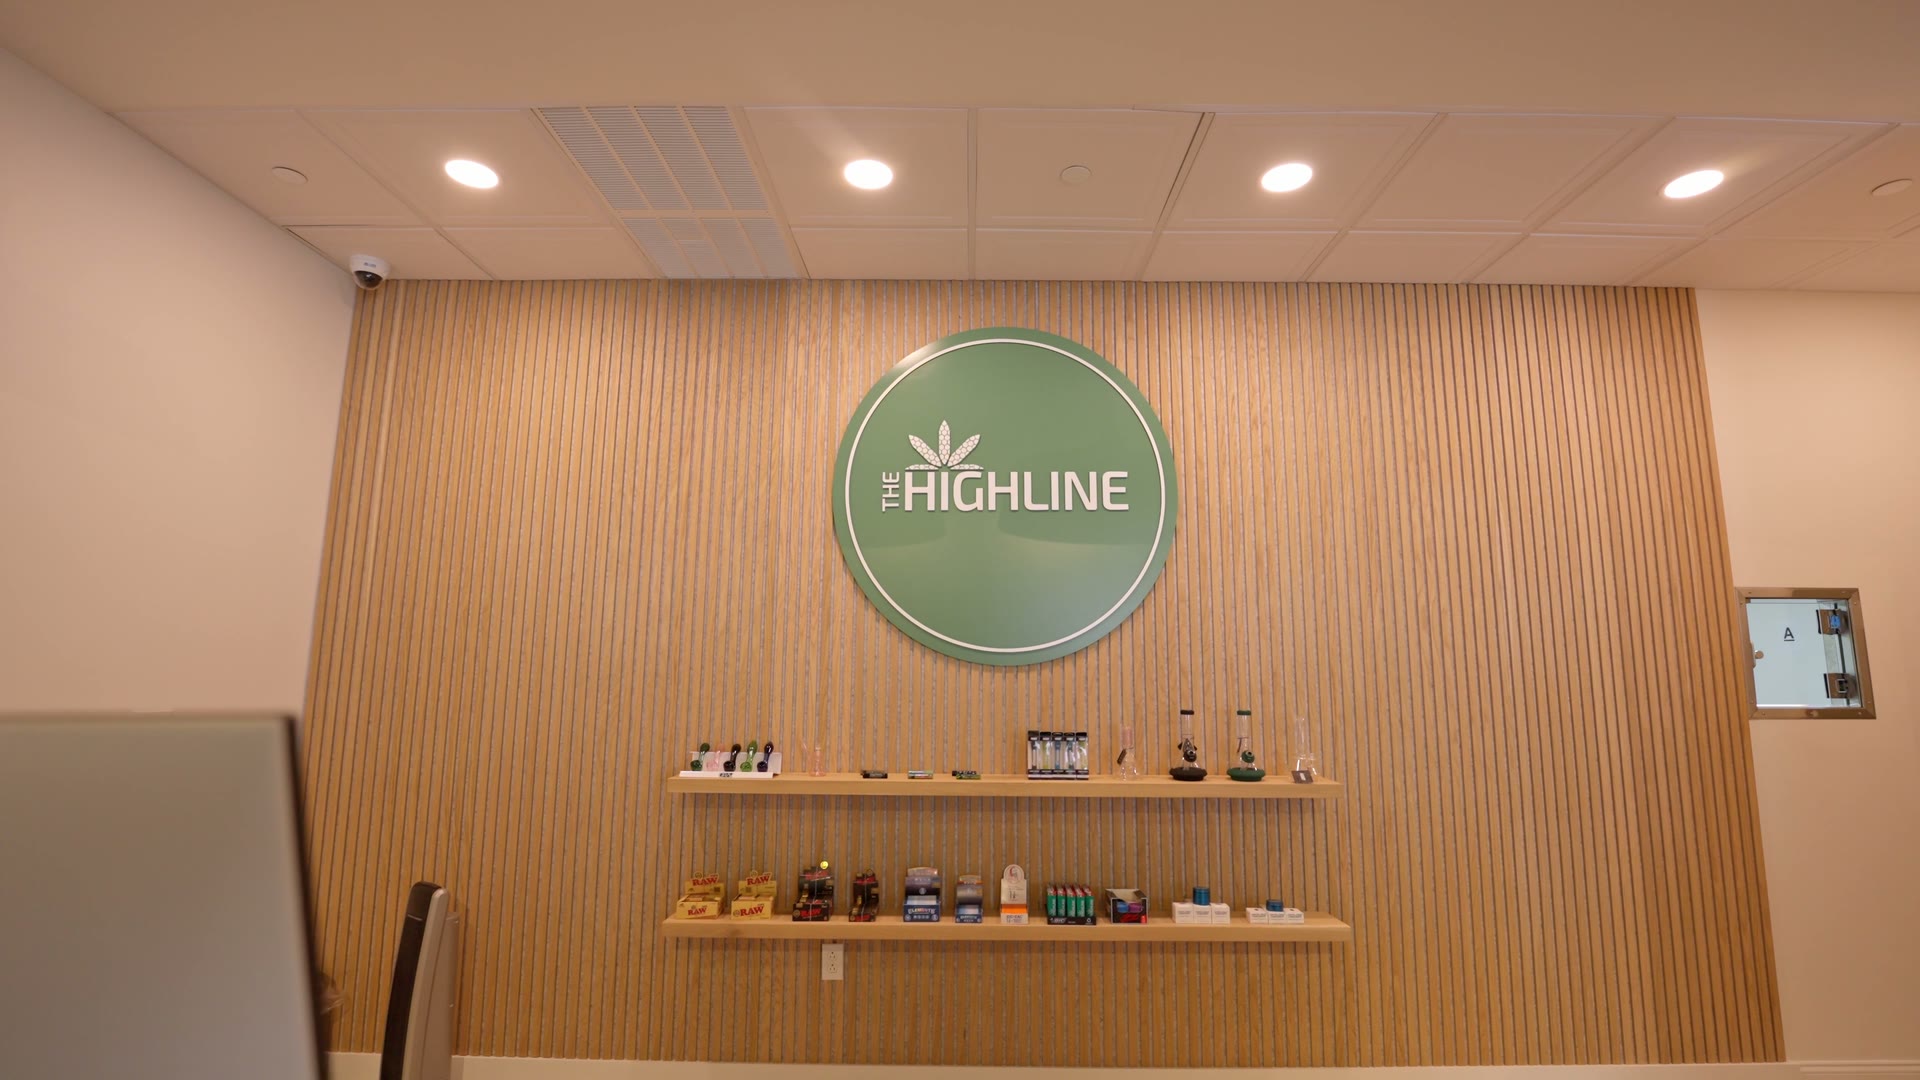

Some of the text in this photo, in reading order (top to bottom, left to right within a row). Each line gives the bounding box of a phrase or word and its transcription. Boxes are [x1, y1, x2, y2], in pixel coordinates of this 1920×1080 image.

[882, 471, 1129, 512] THE HIGHLINE
[1784, 627, 1794, 639] A
[692, 877, 717, 886] RAW
[747, 875, 770, 886] RAW
[687, 908, 707, 916] RAW
[740, 906, 764, 917] RAW
